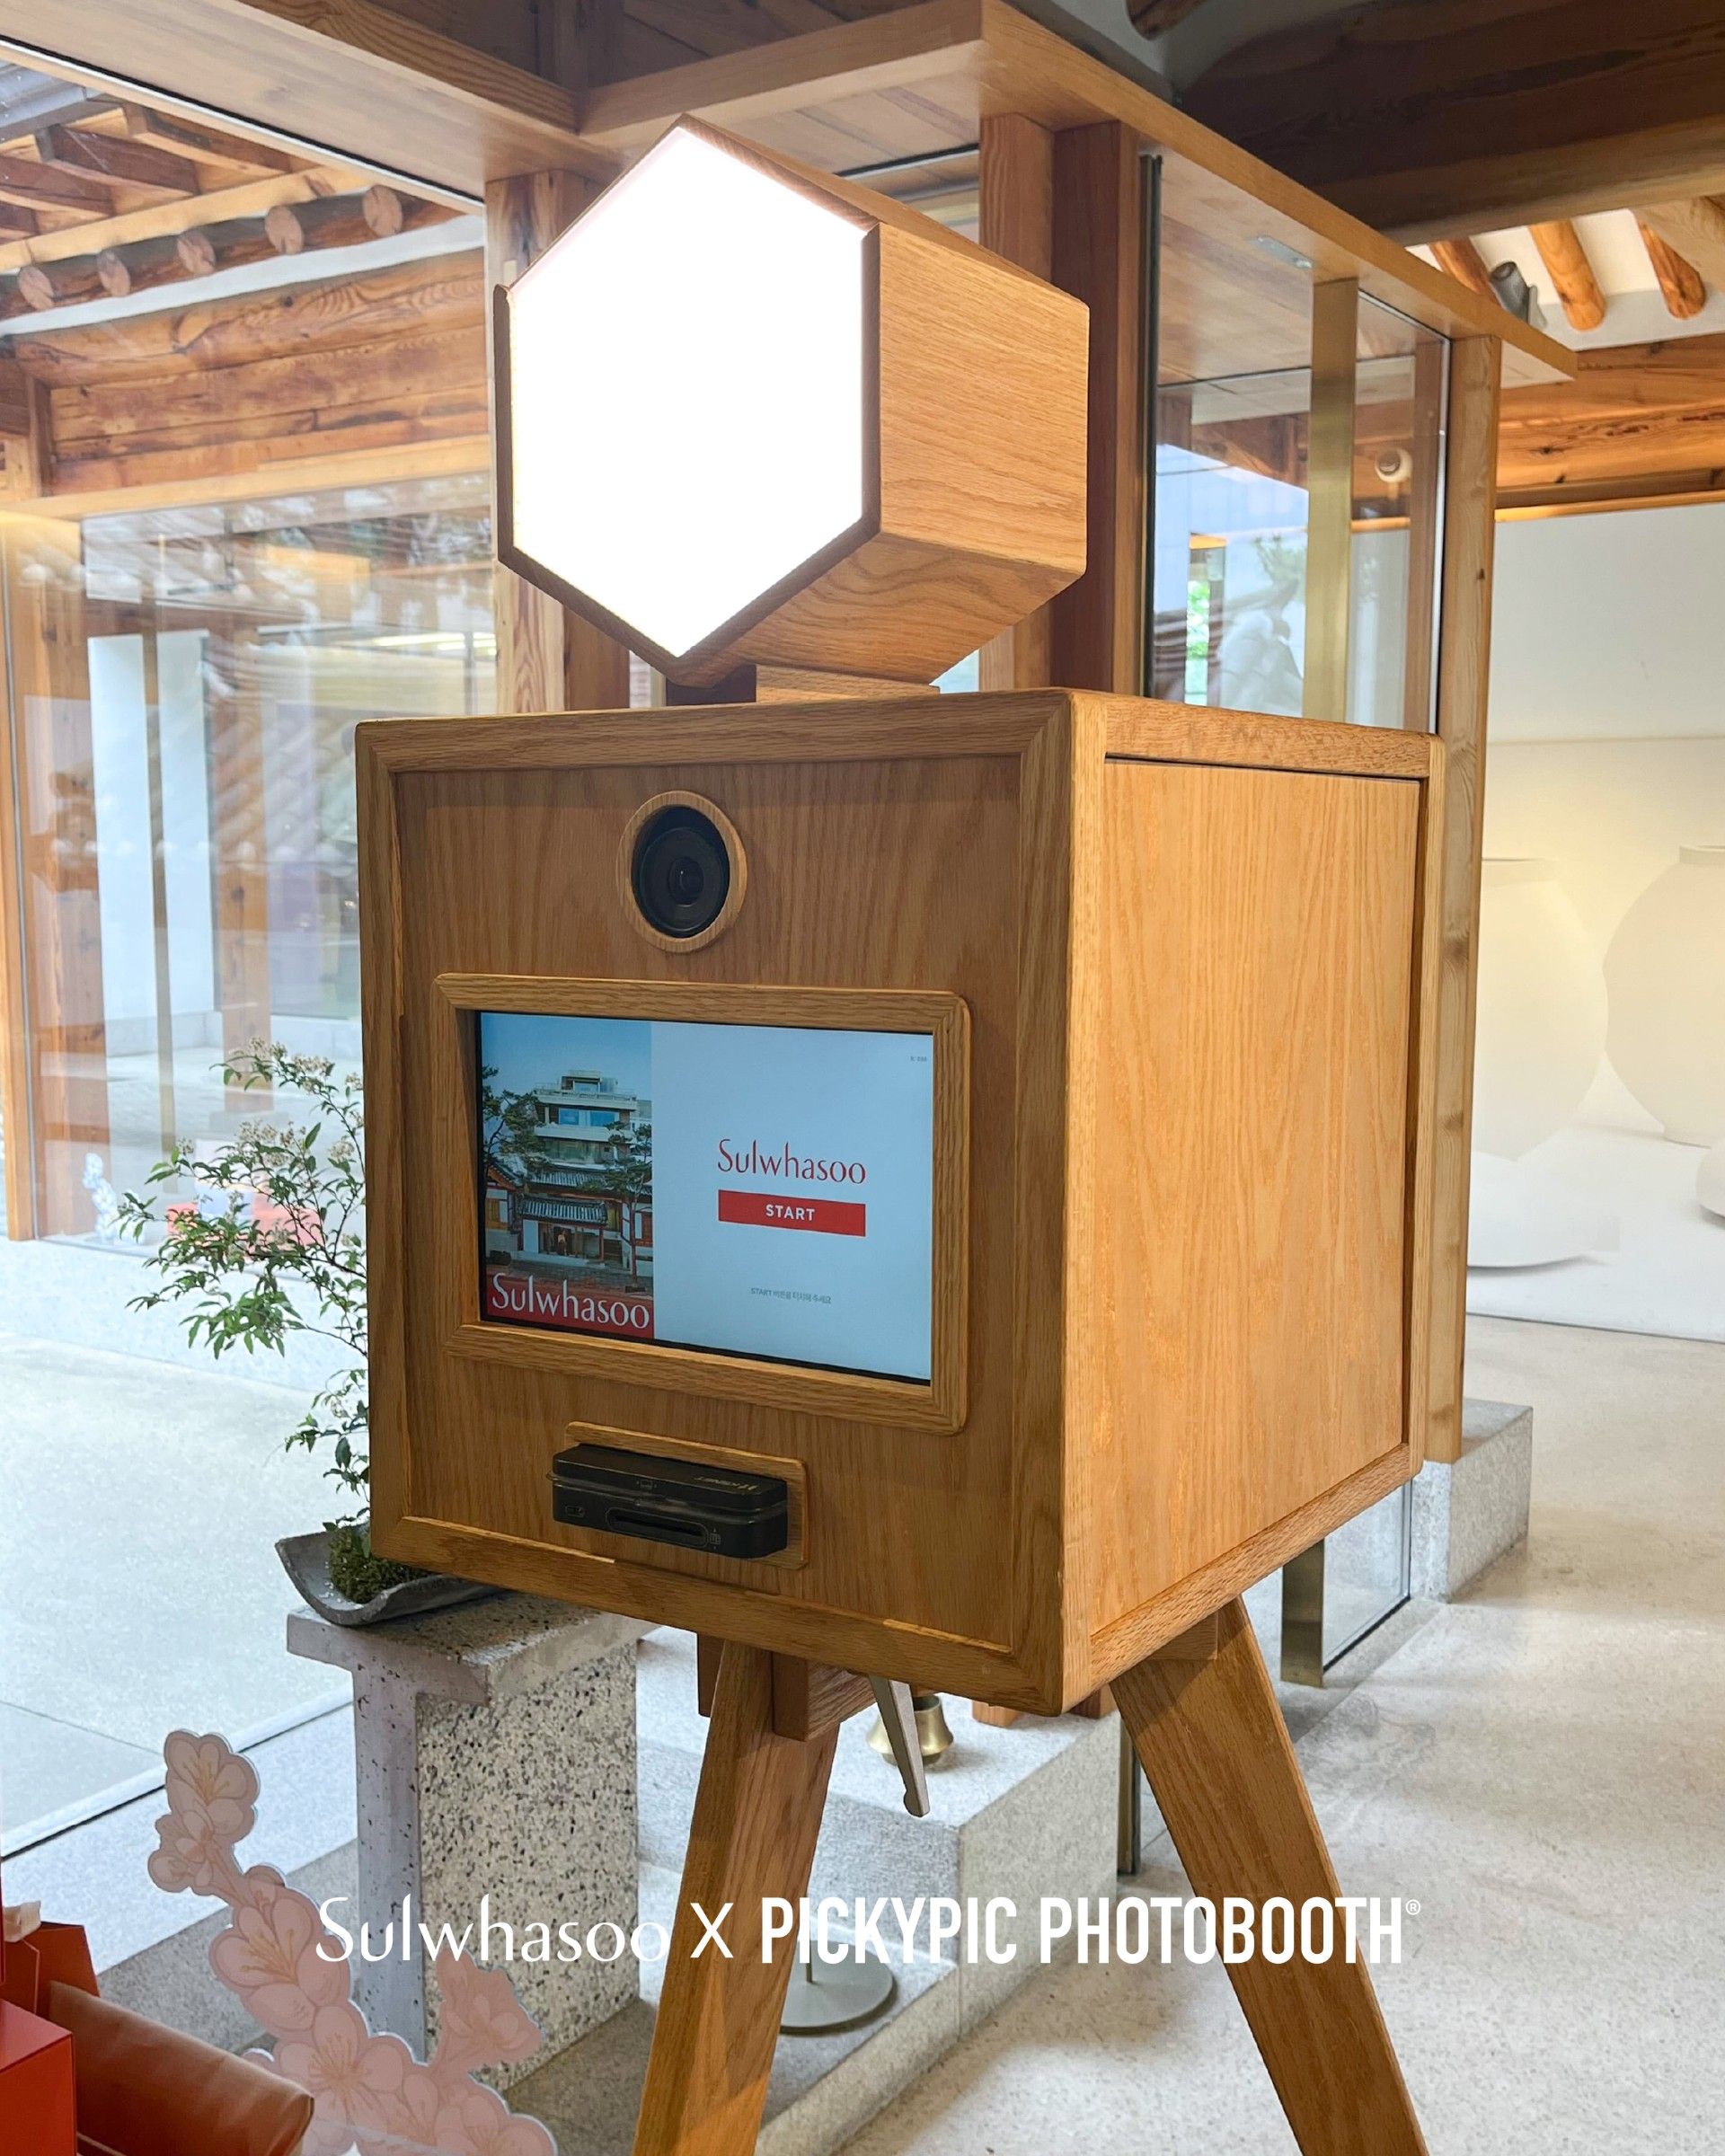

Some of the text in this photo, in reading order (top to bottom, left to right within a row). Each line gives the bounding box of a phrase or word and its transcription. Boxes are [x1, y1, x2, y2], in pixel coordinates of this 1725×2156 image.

[717, 1138, 866, 1184] Sulwhasoo
[765, 1204, 816, 1222] START
[492, 1272, 650, 1330] Sulwhasoo
[750, 1287, 772, 1296] START
